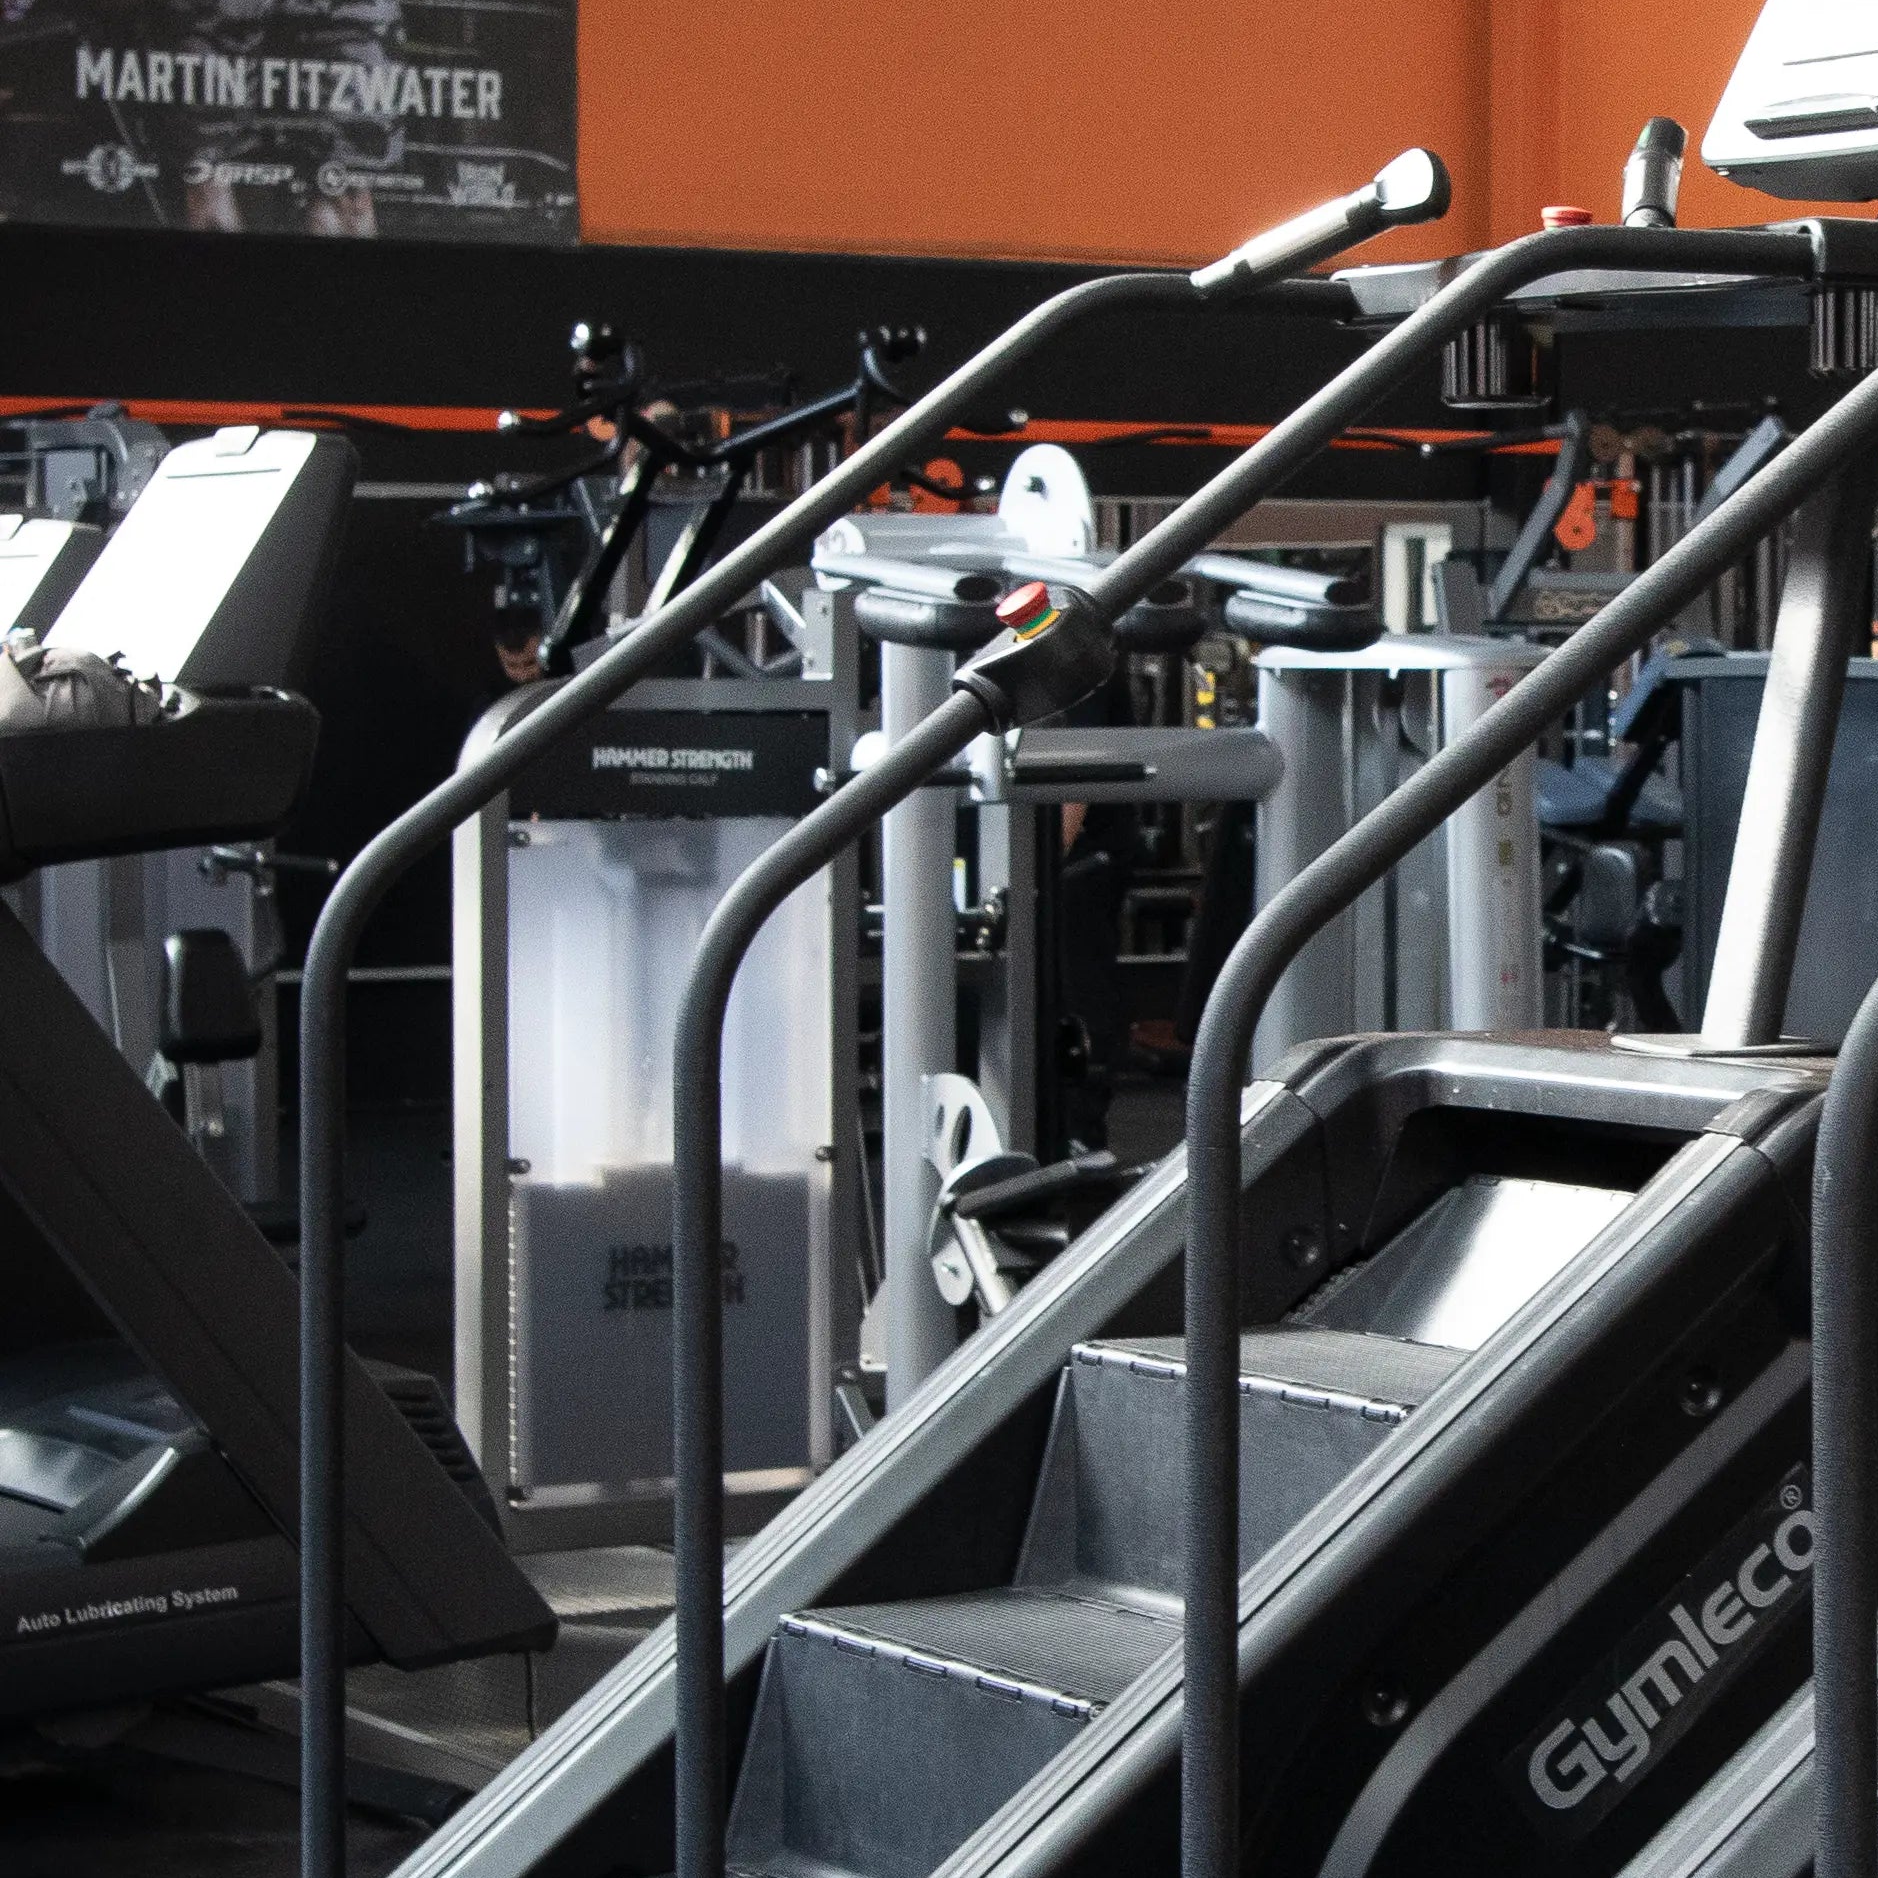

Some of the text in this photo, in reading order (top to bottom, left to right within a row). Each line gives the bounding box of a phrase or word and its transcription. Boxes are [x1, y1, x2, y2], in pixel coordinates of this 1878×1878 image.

[76, 46, 503, 121] MARTIN FITZWATER
[592, 746, 754, 771] HAMMER STRENGTH
[611, 1241, 739, 1274] HAMR
[17, 1584, 240, 1634] Auto Lubricating System
